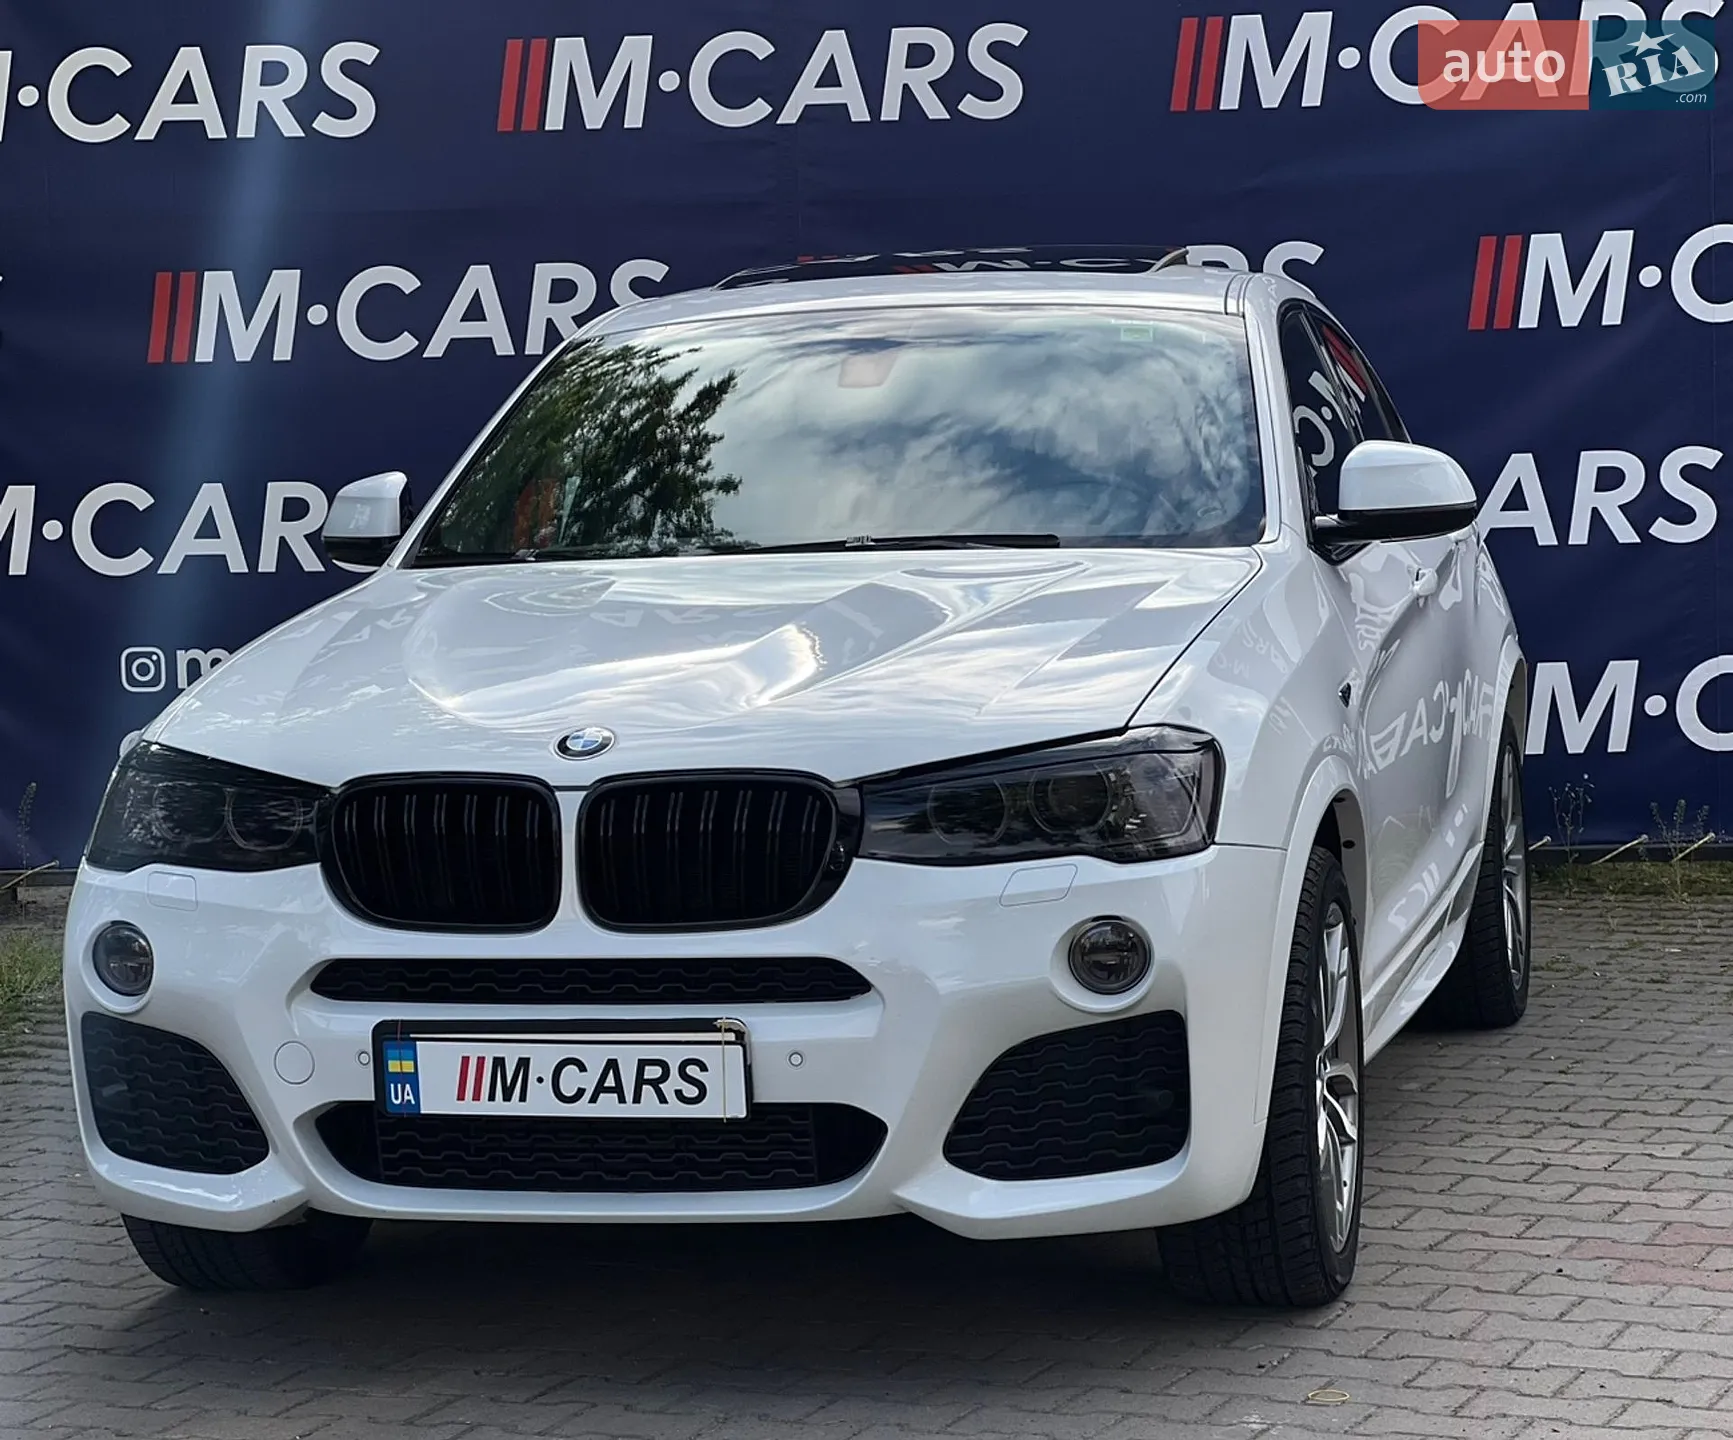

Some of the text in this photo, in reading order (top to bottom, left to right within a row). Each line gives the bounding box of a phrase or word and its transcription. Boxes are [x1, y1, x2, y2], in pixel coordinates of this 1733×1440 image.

[0, 41, 380, 143] ·CARS
[544, 22, 1029, 131] M·CARS
[0, 482, 381, 577] ·CAR
[390, 1082, 416, 1106] UA
[487, 1056, 710, 1105] M·CARS
